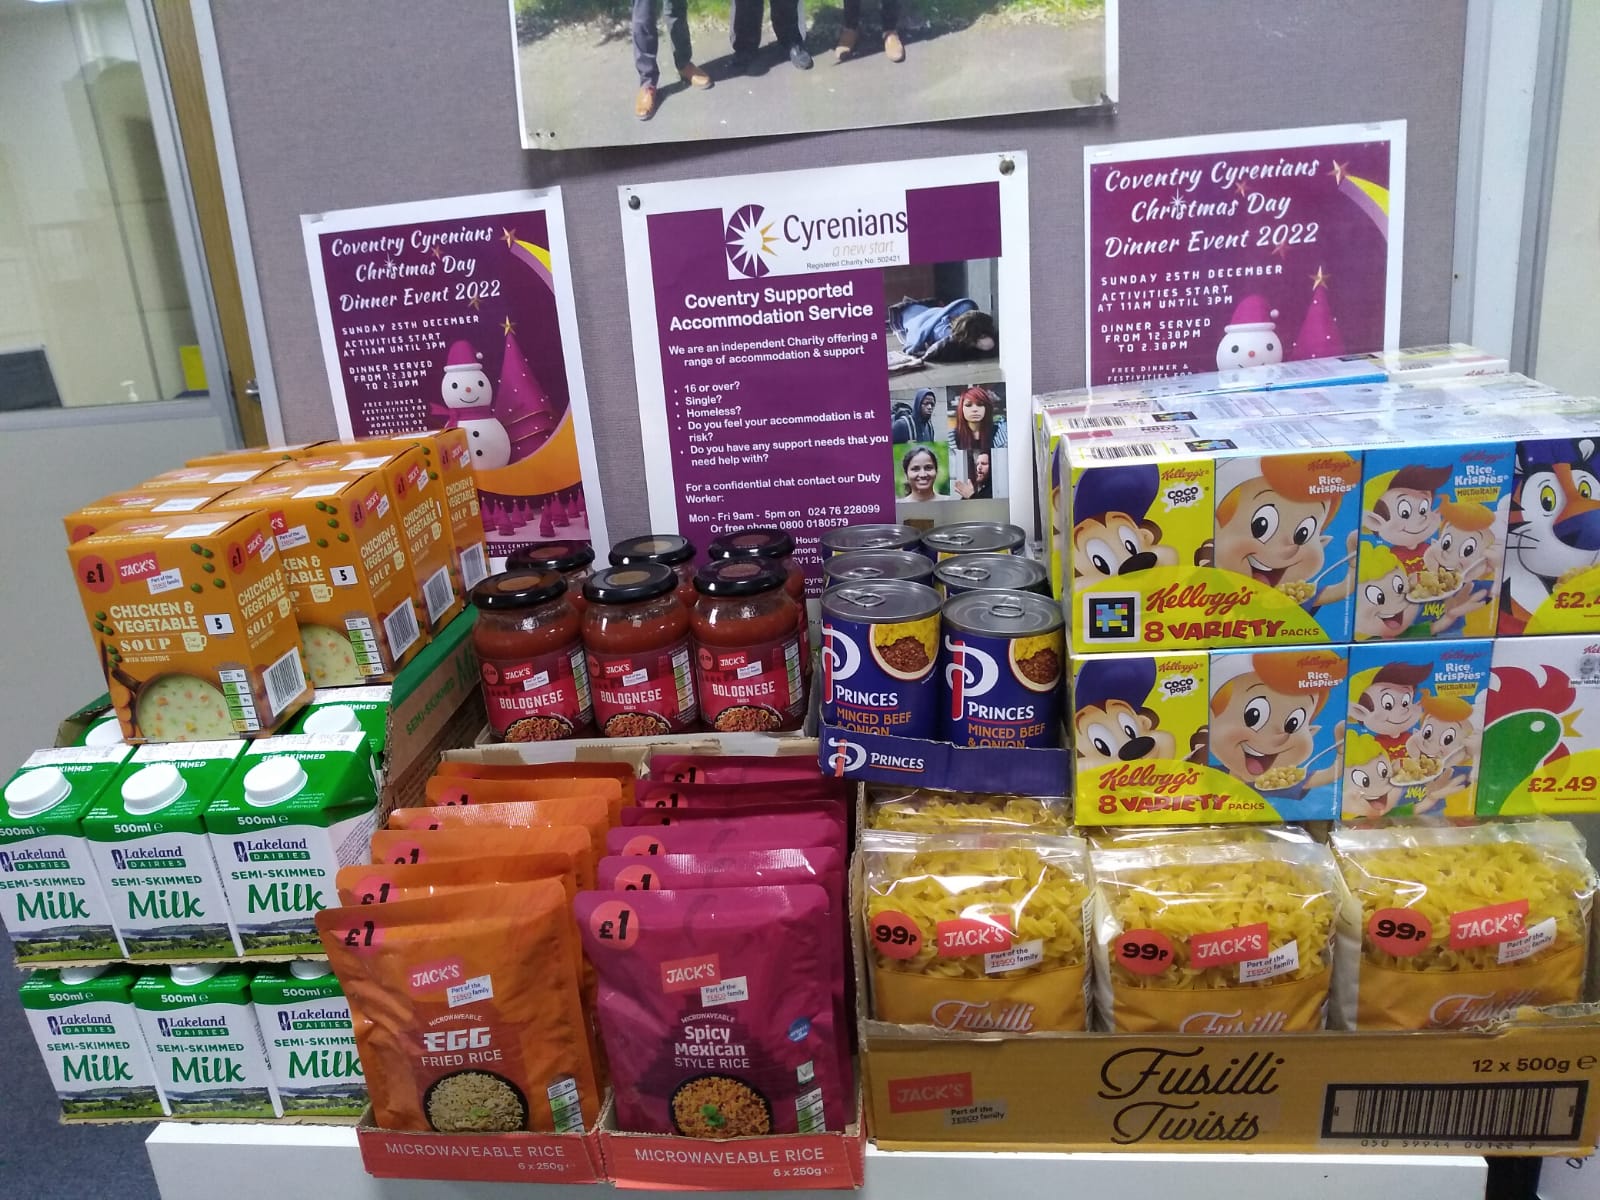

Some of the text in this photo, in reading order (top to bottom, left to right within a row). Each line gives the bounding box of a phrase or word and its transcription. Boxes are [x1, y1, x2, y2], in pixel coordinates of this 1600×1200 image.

[1105, 159, 1319, 192] Coventry Cyrenians
[1131, 192, 1291, 222] Christmas Day
[783, 209, 908, 250] Cyrenians
[331, 226, 494, 256] Coventry Cyrenians
[1104, 222, 1319, 258] Dinner Event 2022
[356, 255, 476, 282] Christmas Day
[807, 258, 838, 270] Registered
[840, 257, 863, 268] Charity
[877, 255, 900, 264] 502421
[1101, 265, 1283, 286] SUNDAY 25TH DECEMBER
[339, 280, 501, 312] Dinner Event 2022
[685, 281, 854, 313] Coventry Supported
[1101, 284, 1230, 301] ACTIVITIES START
[1120, 296, 1233, 311] 11AM UNTIL 3PM
[342, 315, 480, 336] SUNDAY 25TH DECEMBER
[669, 303, 874, 333] Accommodation Service
[1101, 318, 1211, 333] DINNER SERVED
[344, 332, 441, 348] ACTIVITIES START
[668, 331, 866, 356] We are an independent Charity offering
[1105, 330, 1201, 344] FROM 12.30PM
[1142, 341, 1188, 352] 2.30PM
[684, 345, 865, 369] range accommodation support
[349, 360, 433, 375] DINNER SERVED
[712, 381, 740, 392] over?
[685, 395, 722, 407] Single?
[686, 406, 742, 418] Homeless?
[724, 411, 851, 428] feel your accommodation
[689, 432, 714, 442] risk?
[726, 434, 868, 453] have support needs that
[691, 453, 769, 466] need help with?
[686, 472, 881, 492] For confidential chat contact our Duty
[1308, 482, 1352, 494] Krispies
[1318, 476, 1342, 486] Rice
[685, 493, 724, 504] Worker:
[1173, 493, 1196, 506] pops
[688, 504, 880, 523] Mon Fri 9am 5pm on 024 76 228099
[779, 518, 848, 530] 0800 0180579
[87, 562, 104, 584] £1
[120, 559, 156, 577] JACK'S
[1146, 583, 1254, 616] Kellogg's
[110, 601, 182, 619] CHICKEN
[112, 615, 199, 634] VEGETABLE
[1144, 618, 1319, 642] 8 VARIETY PACKS
[120, 637, 171, 652] SOUP
[720, 654, 745, 667] JACK'S
[1298, 679, 1339, 689] Krispies
[1307, 671, 1330, 680] Rice
[600, 688, 662, 705] BOLOGNESE
[712, 681, 775, 697] BOLOGNESE
[835, 684, 898, 707] PRINCES
[500, 689, 564, 710] BOLOGNESE
[836, 707, 912, 725] MINCED BEEF
[967, 701, 1035, 720] PRINCES
[968, 723, 1045, 738] MINCED BEEF
[870, 752, 924, 769] PRINCES
[1099, 764, 1200, 794] Kellogg's
[1527, 776, 1597, 793] £2.49
[1098, 794, 1265, 814] 8 VARIETY PACKS
[113, 823, 151, 833] 500ml
[124, 846, 182, 858] Lakeland
[248, 838, 307, 851] Lakeland
[11, 848, 66, 861] Lakeland
[111, 875, 202, 887] SEMI-SKIMMED
[231, 869, 326, 880] SEMI-SKIMMED
[16, 891, 90, 922] Milk
[128, 889, 205, 920] Milk
[250, 882, 327, 913] Milk
[345, 920, 375, 947] £1
[599, 909, 630, 941] £1
[1456, 913, 1523, 940] JACK'S
[1198, 935, 1262, 959] JACK'S
[412, 963, 460, 988] JACK'S
[666, 963, 716, 984] JACK'S
[59, 1013, 113, 1026] Lakeland
[931, 999, 1036, 1032] Fusilli
[423, 1026, 491, 1052] EGG
[684, 1025, 730, 1044] Spicy
[47, 1041, 131, 1051] SEMI-SKIMMED
[674, 1042, 746, 1057] Mexican
[421, 1050, 503, 1067] FRIED RICE
[674, 1057, 751, 1069] STYLE RICE
[1472, 1057, 1571, 1074] 12 500g
[62, 1054, 134, 1082] Milk
[172, 1055, 246, 1083] Milk
[1096, 1045, 1285, 1100] Fusilli
[1110, 1100, 1261, 1145] Twists
[385, 1142, 565, 1157] MICROWAVEABLE RICE
[634, 1147, 824, 1165] MICROWAVEABLE RICE
